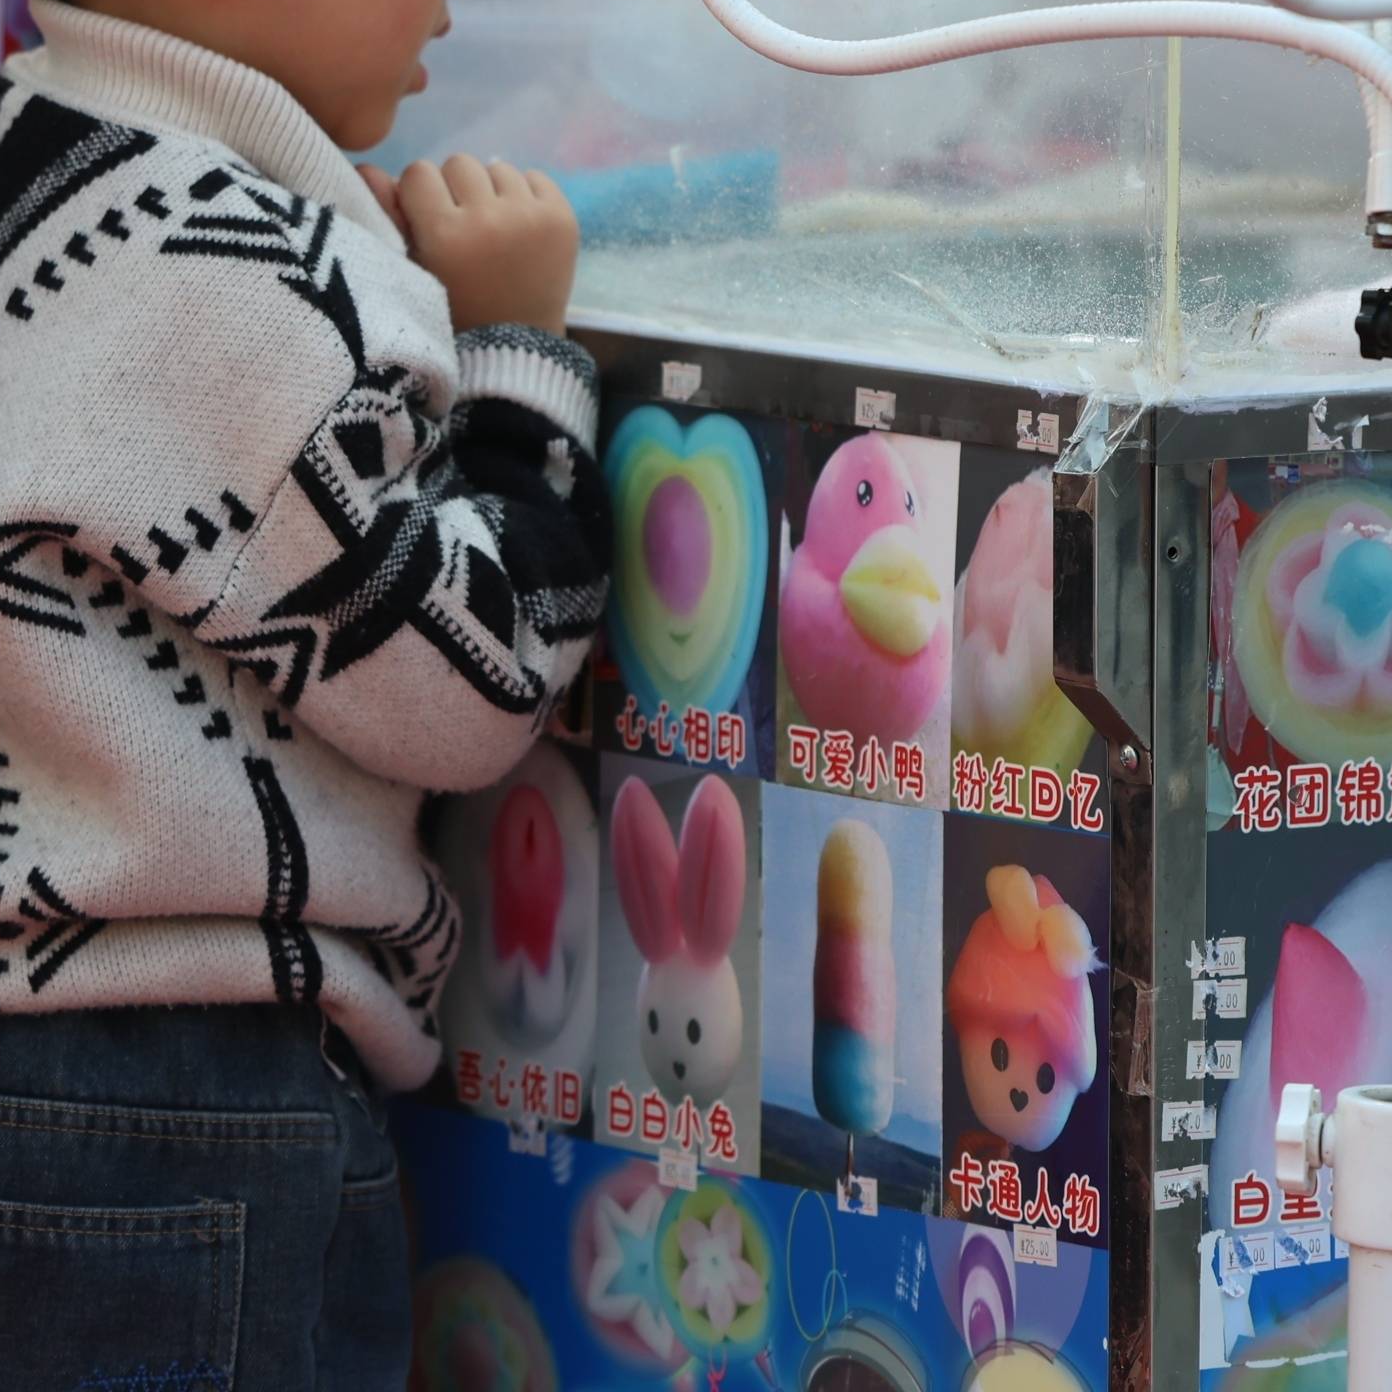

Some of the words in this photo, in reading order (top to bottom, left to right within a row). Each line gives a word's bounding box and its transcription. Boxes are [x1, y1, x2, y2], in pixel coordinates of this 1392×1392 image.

[616, 694, 746, 770] 心心相印
[787, 724, 927, 800] 可爱小鸭
[951, 750, 1105, 832] 粉红回忆
[456, 1050, 583, 1123] 吾心依旧
[609, 1082, 737, 1160] 白白小兔
[950, 1153, 1100, 1237] 卡通人物
[1020, 1239, 1050, 1257] ¥25.00
